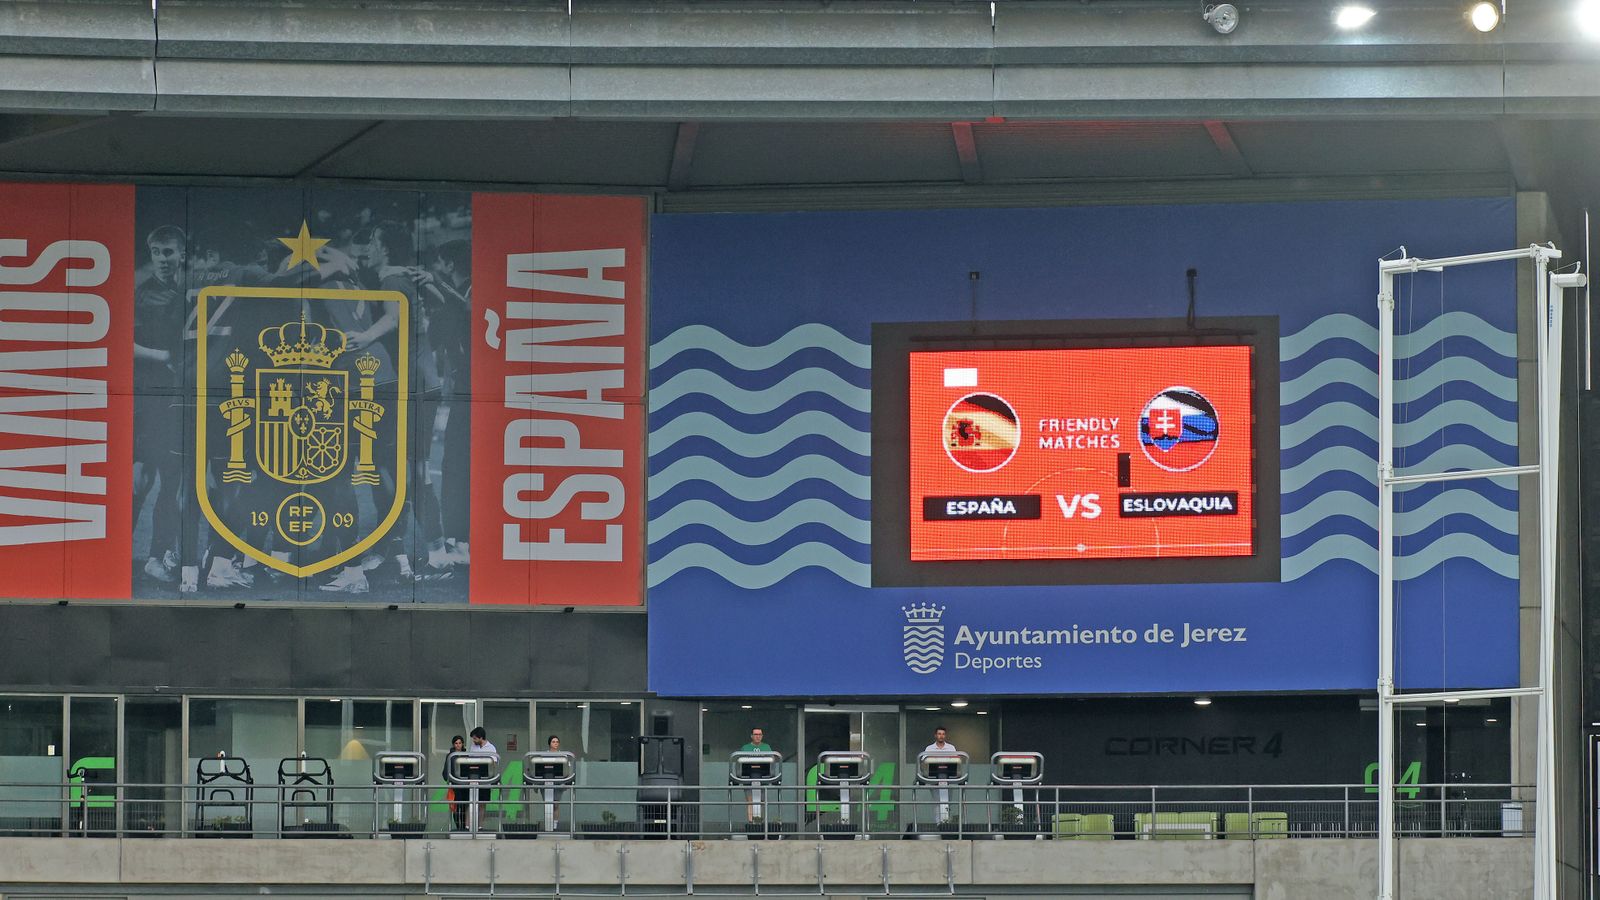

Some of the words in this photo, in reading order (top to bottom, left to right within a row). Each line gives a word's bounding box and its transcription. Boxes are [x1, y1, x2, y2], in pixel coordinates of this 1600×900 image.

[0, 238, 111, 546] VAMOS
[226, 400, 250, 408] PLVS
[351, 401, 382, 413] VLTRA
[485, 247, 626, 562] ESPAÑA
[1038, 417, 1120, 434] FRIENDLY
[1038, 434, 1121, 449] MATCHES
[289, 506, 314, 518] RF
[946, 497, 1016, 516] ESPAÑA
[1056, 493, 1102, 520] VS
[1123, 495, 1233, 515] ESLOVAQUIA
[251, 511, 269, 527] 19
[289, 521, 314, 533] EF
[332, 512, 354, 528] 09
[954, 625, 1137, 650] Ayuntamiento
[1143, 624, 1174, 643] de
[1180, 622, 1247, 648] Jerez
[955, 652, 1042, 674] Deportes
[1105, 737, 1255, 757] CORNER
[1263, 732, 1284, 759] 4
